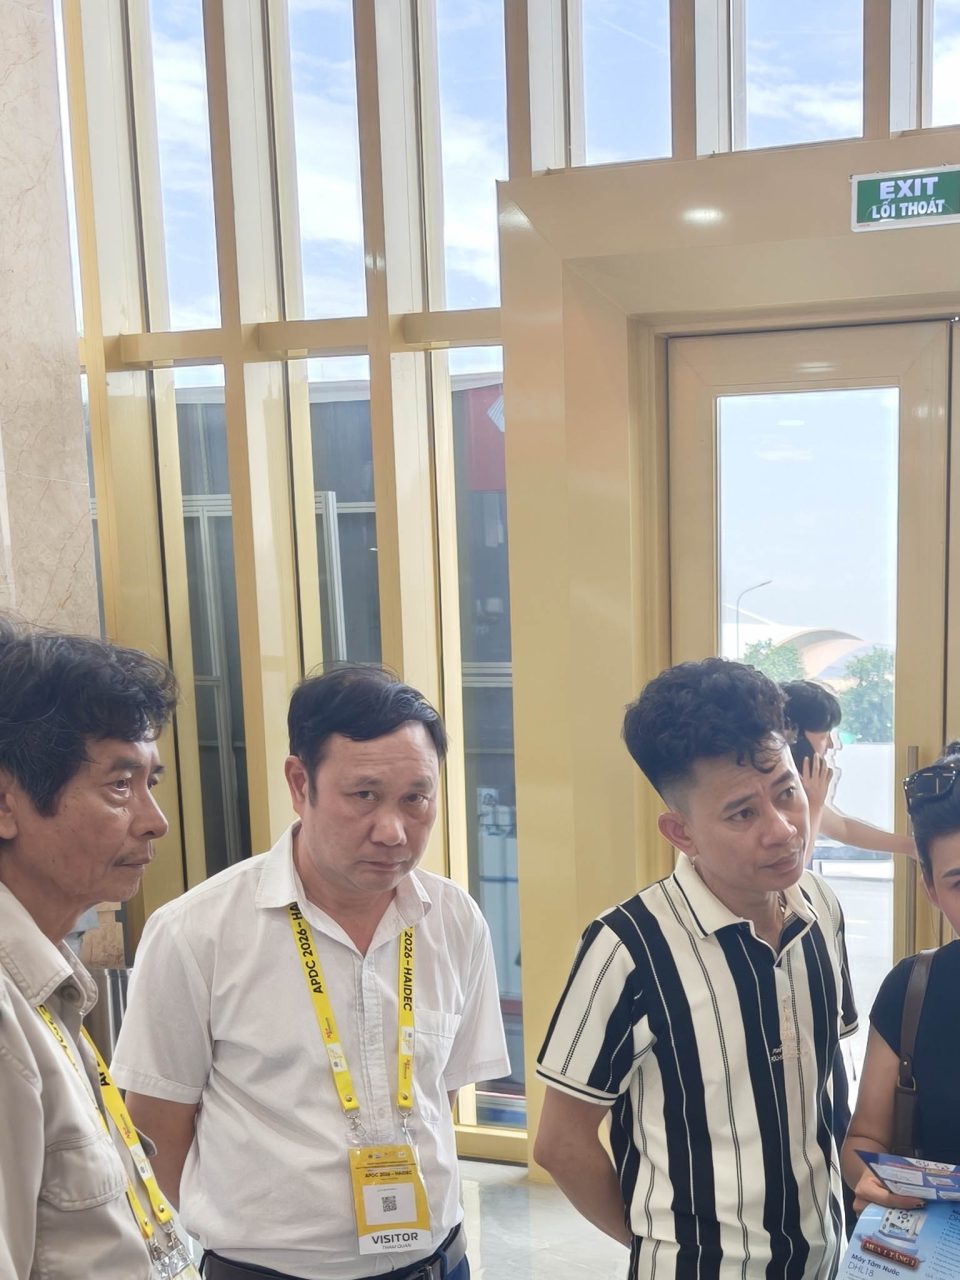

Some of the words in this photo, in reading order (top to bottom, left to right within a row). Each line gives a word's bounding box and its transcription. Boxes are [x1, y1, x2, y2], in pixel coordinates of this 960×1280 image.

[879, 176, 938, 200] EXIT
[872, 197, 896, 219] LỐI
[900, 196, 945, 216] THOÁT
[296, 928, 314, 957] 2026
[404, 931, 413, 959] 2026
[306, 960, 324, 994] APDC
[403, 967, 413, 1012] HAIDEC
[372, 1232, 418, 1244] VISITOR
[848, 1261, 874, 1277] DHL18
[851, 1253, 868, 1265] Máy
